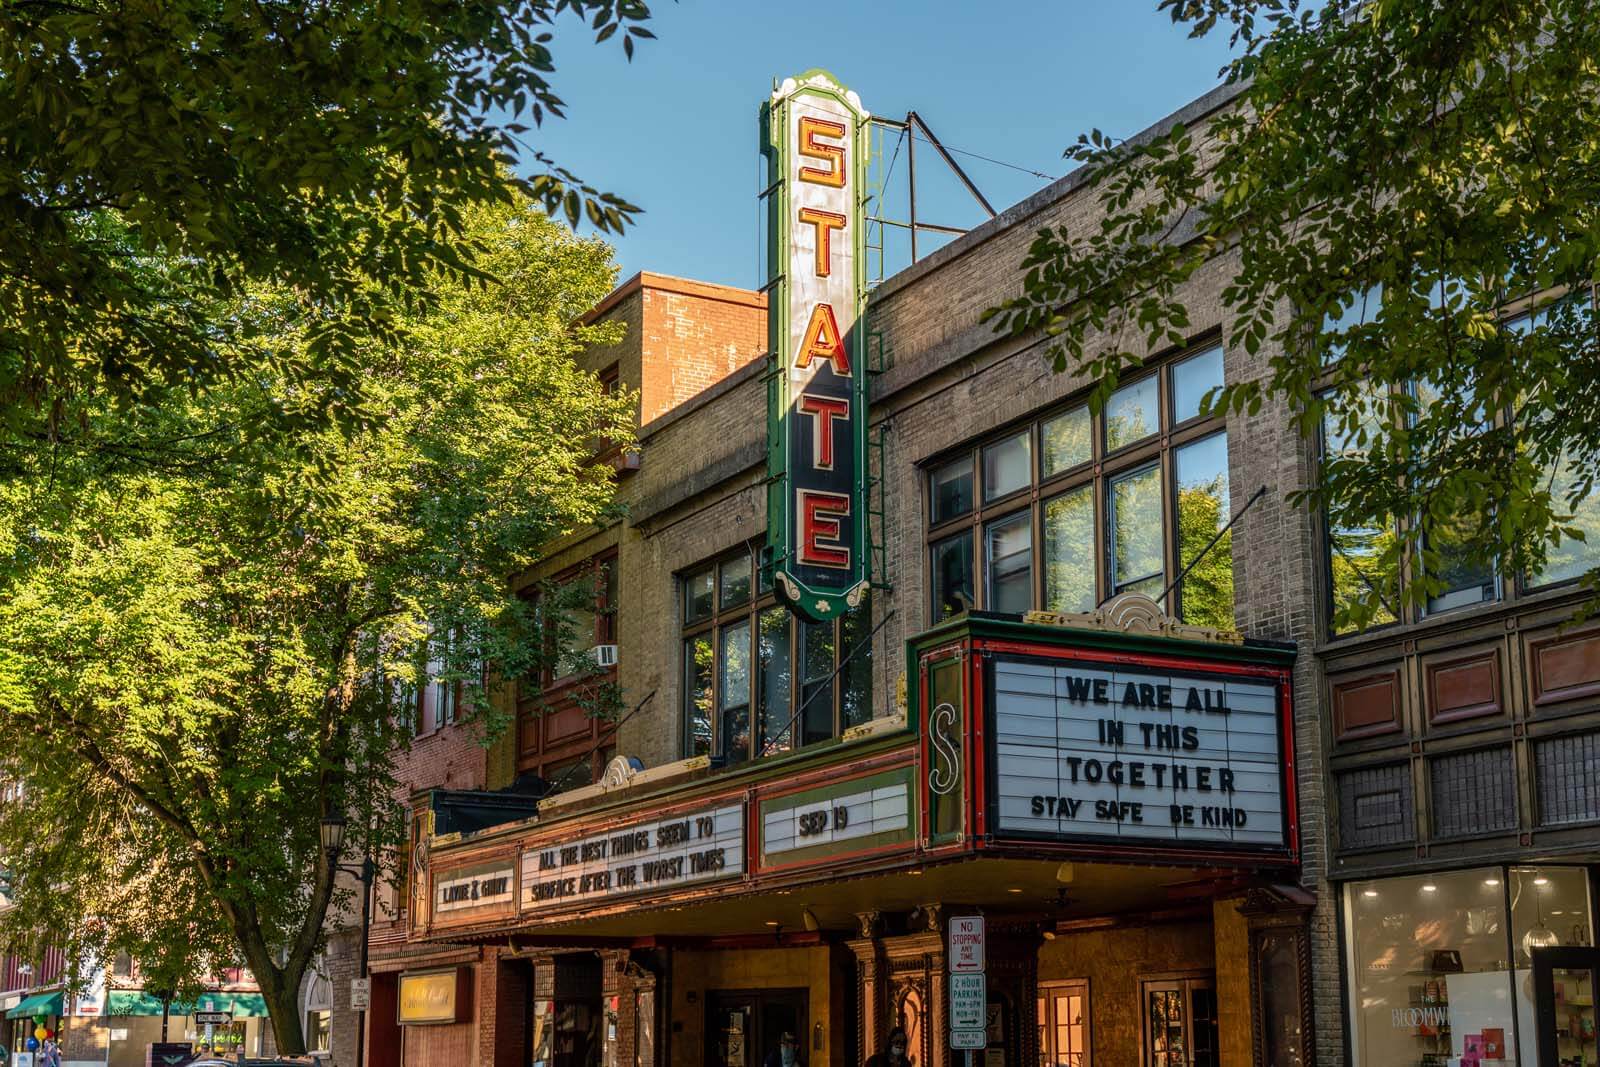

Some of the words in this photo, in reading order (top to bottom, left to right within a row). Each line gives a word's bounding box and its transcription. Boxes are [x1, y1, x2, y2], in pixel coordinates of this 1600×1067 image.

[796, 115, 851, 568] STATE
[1066, 676, 1109, 705] WE
[1123, 682, 1172, 709] ARE
[1185, 687, 1231, 714] ALL
[1098, 719, 1124, 746] IN
[1140, 723, 1199, 750] THIS
[1067, 757, 1235, 794] TOGETHER
[799, 810, 827, 836] SEP
[833, 806, 848, 831] 19
[1031, 796, 1082, 818] STAY
[1095, 800, 1143, 822] SAFE
[1170, 805, 1194, 825] BE
[1201, 807, 1247, 828] KIND
[539, 851, 556, 871] ALL
[560, 846, 579, 867] THE
[581, 840, 607, 863] BEST
[611, 831, 649, 857] THINGS
[657, 820, 690, 847] SEEM
[696, 816, 713, 840] TO
[532, 877, 576, 901] SURFACE
[579, 870, 611, 894] AFTER
[616, 865, 637, 888] THE
[642, 856, 684, 883] WORST
[689, 848, 725, 874] TIMES
[952, 934, 981, 945] STOPPING
[960, 921, 973, 932] NO
[960, 945, 973, 953] ANY
[953, 989, 982, 999] PARKING
[955, 978, 960, 987] 2
[961, 978, 980, 987] HOUR
